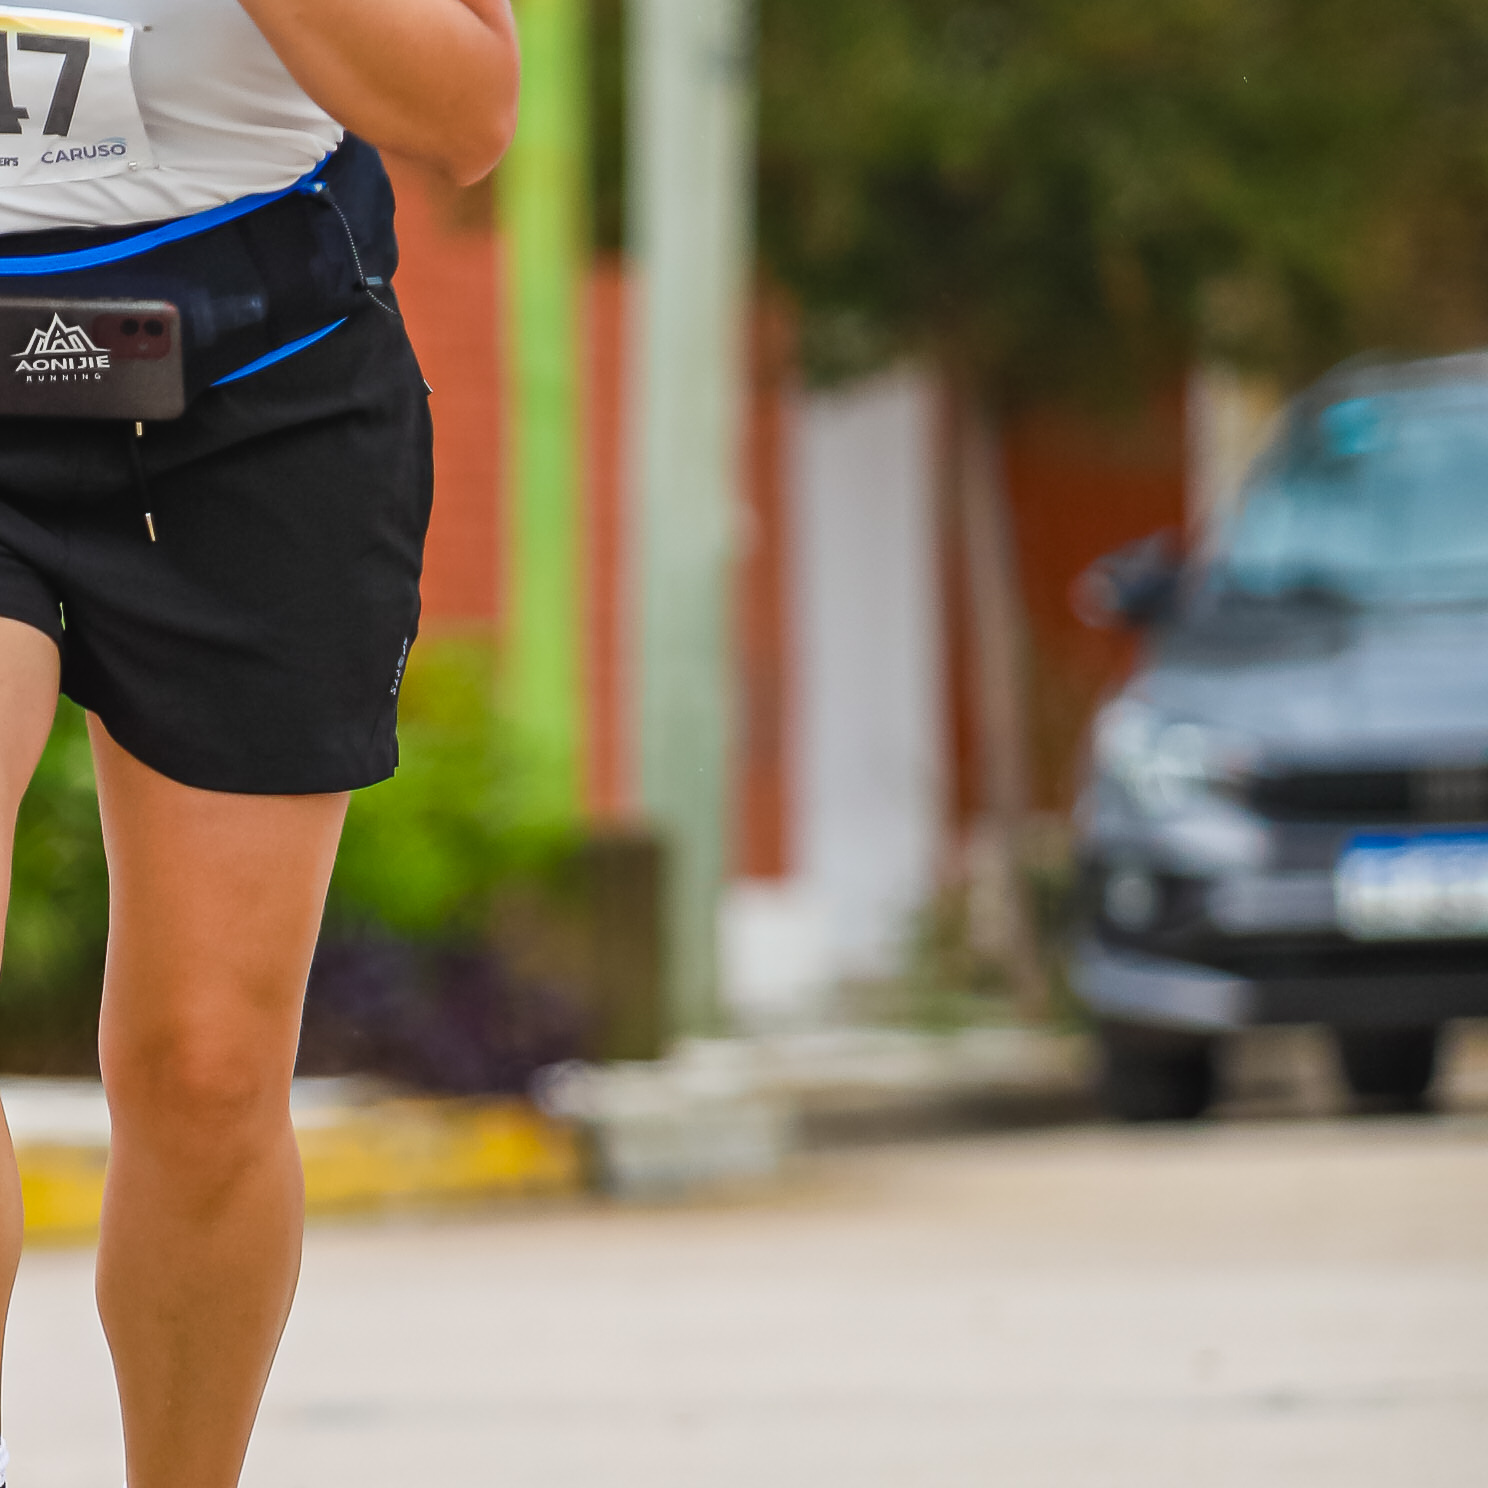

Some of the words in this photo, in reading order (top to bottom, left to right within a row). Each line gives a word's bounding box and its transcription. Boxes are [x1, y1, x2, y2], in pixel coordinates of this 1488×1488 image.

[41, 143, 127, 164] CARUSO
[15, 354, 110, 372] AONIJIE
[26, 372, 101, 382] RUNNING
